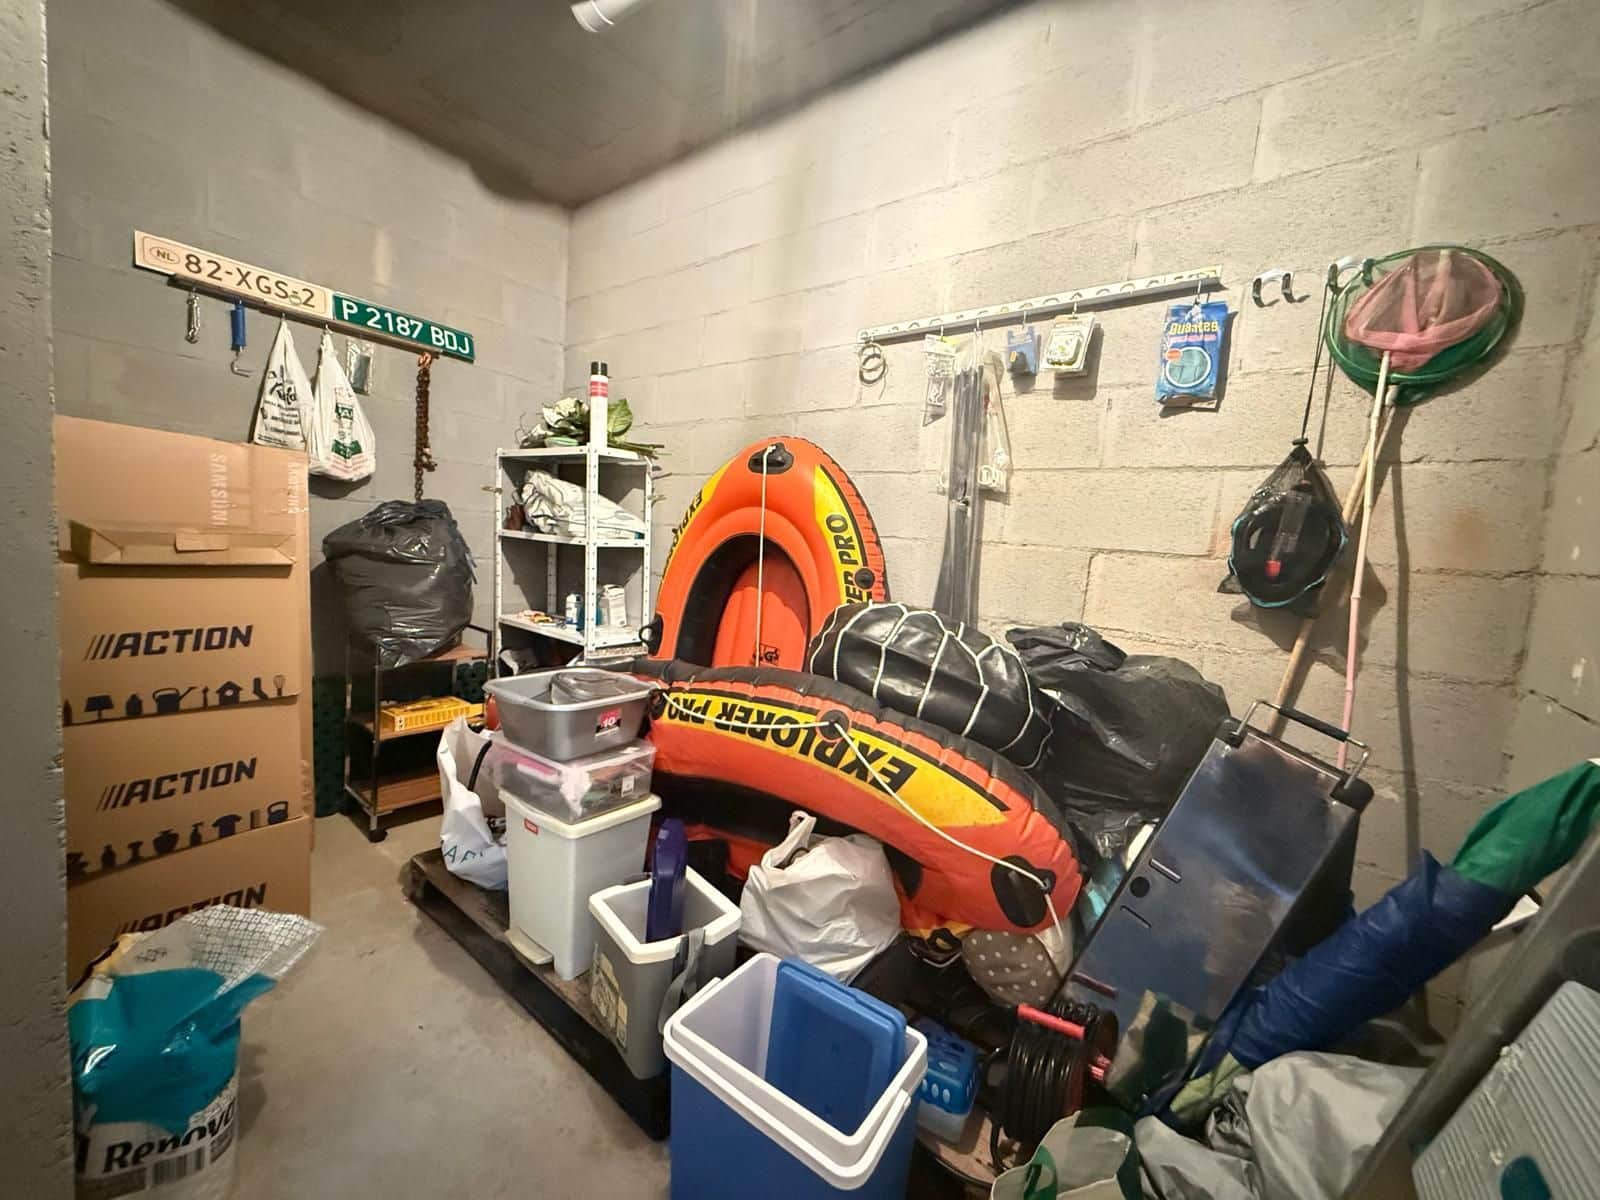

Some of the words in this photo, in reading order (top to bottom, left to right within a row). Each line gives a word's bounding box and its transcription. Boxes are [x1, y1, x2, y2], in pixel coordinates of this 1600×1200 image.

[156, 248, 175, 262] NL
[185, 253, 315, 308] 82-XGS-2
[341, 298, 359, 321] P
[366, 306, 424, 339] 2187
[430, 326, 471, 354] BDJ
[826, 514, 859, 565] PRO
[109, 624, 254, 659] ACTION
[667, 697, 712, 724] PRO
[714, 702, 917, 797] EXPLORER
[121, 757, 257, 807] ACTION
